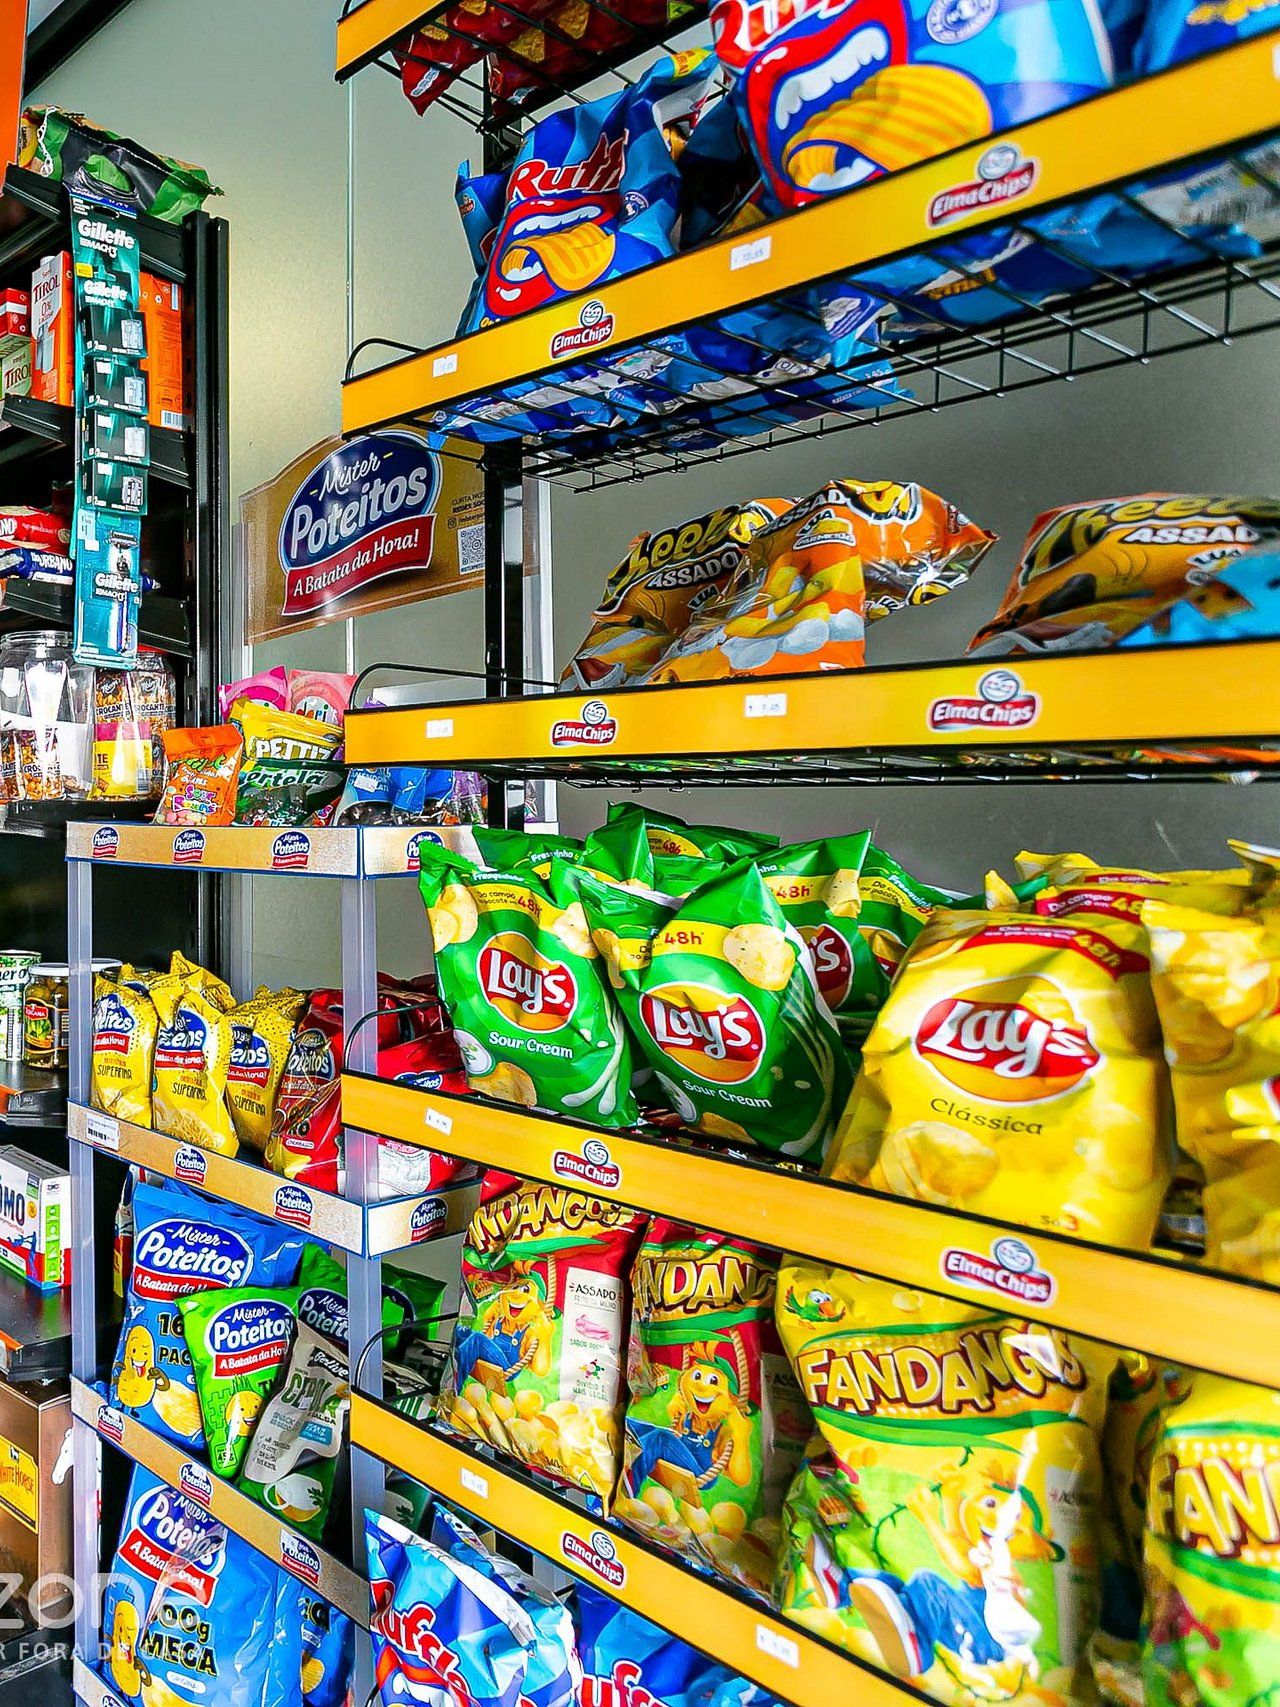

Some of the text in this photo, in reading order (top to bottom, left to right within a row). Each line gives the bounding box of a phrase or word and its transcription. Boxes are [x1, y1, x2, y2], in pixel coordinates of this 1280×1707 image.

[507, 129, 629, 200] Ruff
[78, 219, 135, 249] Gillette
[33, 274, 60, 304] TIROL
[83, 279, 128, 300] Gillette
[319, 452, 381, 501] Mister
[291, 467, 427, 559] Poteitos
[1123, 525, 1261, 544] ASSAD
[294, 529, 419, 597] A Batata da Hora!
[646, 550, 739, 588] ASSADO
[95, 572, 139, 594] Gillette
[175, 838, 204, 851] Poteitos
[275, 840, 310, 854] Poteitos
[776, 884, 811, 899] 48h
[888, 875, 933, 909] Fresquinh
[664, 931, 703, 945] 48h
[488, 947, 567, 1014] Lay's
[649, 996, 753, 1060] Lay's
[922, 1000, 1088, 1079] Lay's
[489, 1031, 573, 1059] Sour Cream
[97, 1064, 132, 1080] SUPERFINA
[172, 1083, 207, 1101] SUPERFINA
[682, 1079, 773, 1109] Sour Cream
[234, 1095, 267, 1117] SUPERFINA
[930, 1097, 1043, 1137] Clássica
[176, 1151, 205, 1171] Poteitos
[277, 1192, 312, 1212] Poteitos
[413, 1206, 446, 1230] Poteitos
[469, 1185, 621, 1252] NDANGOS
[172, 1223, 221, 1246] Mister
[138, 1231, 245, 1283] Poteitos
[136, 1274, 196, 1293] A Batata da
[575, 1284, 616, 1301] ASSADO
[232, 1301, 268, 1322] Mister
[302, 1296, 349, 1341] Poteit
[214, 1317, 294, 1349] Poteitos
[220, 1350, 271, 1369] A Batata da
[798, 1322, 1086, 1416] FANDANGS
[181, 1470, 212, 1493] Poteitos
[130, 1541, 140, 1557] A
[283, 1545, 318, 1571] Poteitos
[156, 1603, 210, 1641] 00g
[142, 1629, 217, 1676] MEGA
